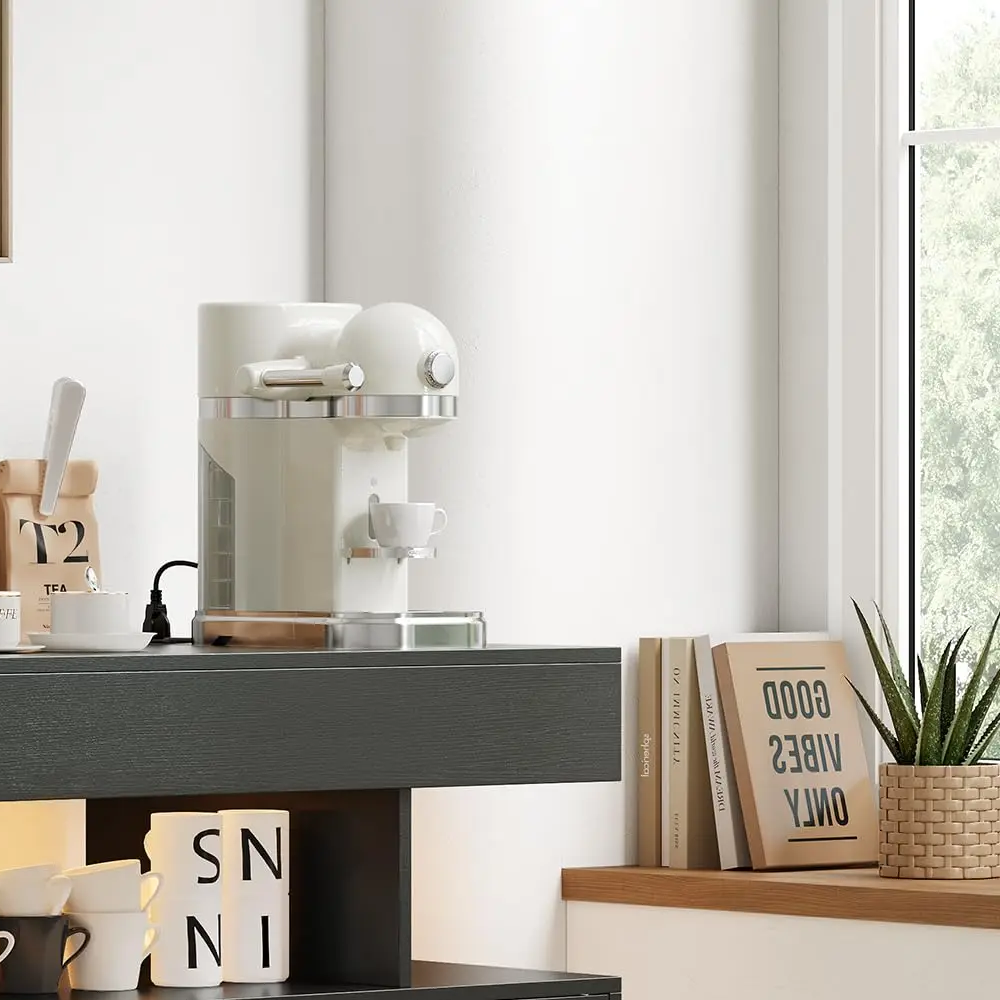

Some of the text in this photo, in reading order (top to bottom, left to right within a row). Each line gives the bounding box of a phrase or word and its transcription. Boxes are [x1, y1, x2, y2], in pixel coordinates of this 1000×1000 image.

[19, 519, 89, 564] T2
[43, 584, 67, 595] TEA
[193, 829, 220, 884] S
[241, 827, 282, 880] N
[186, 914, 221, 969] N
[261, 916, 270, 968] I
